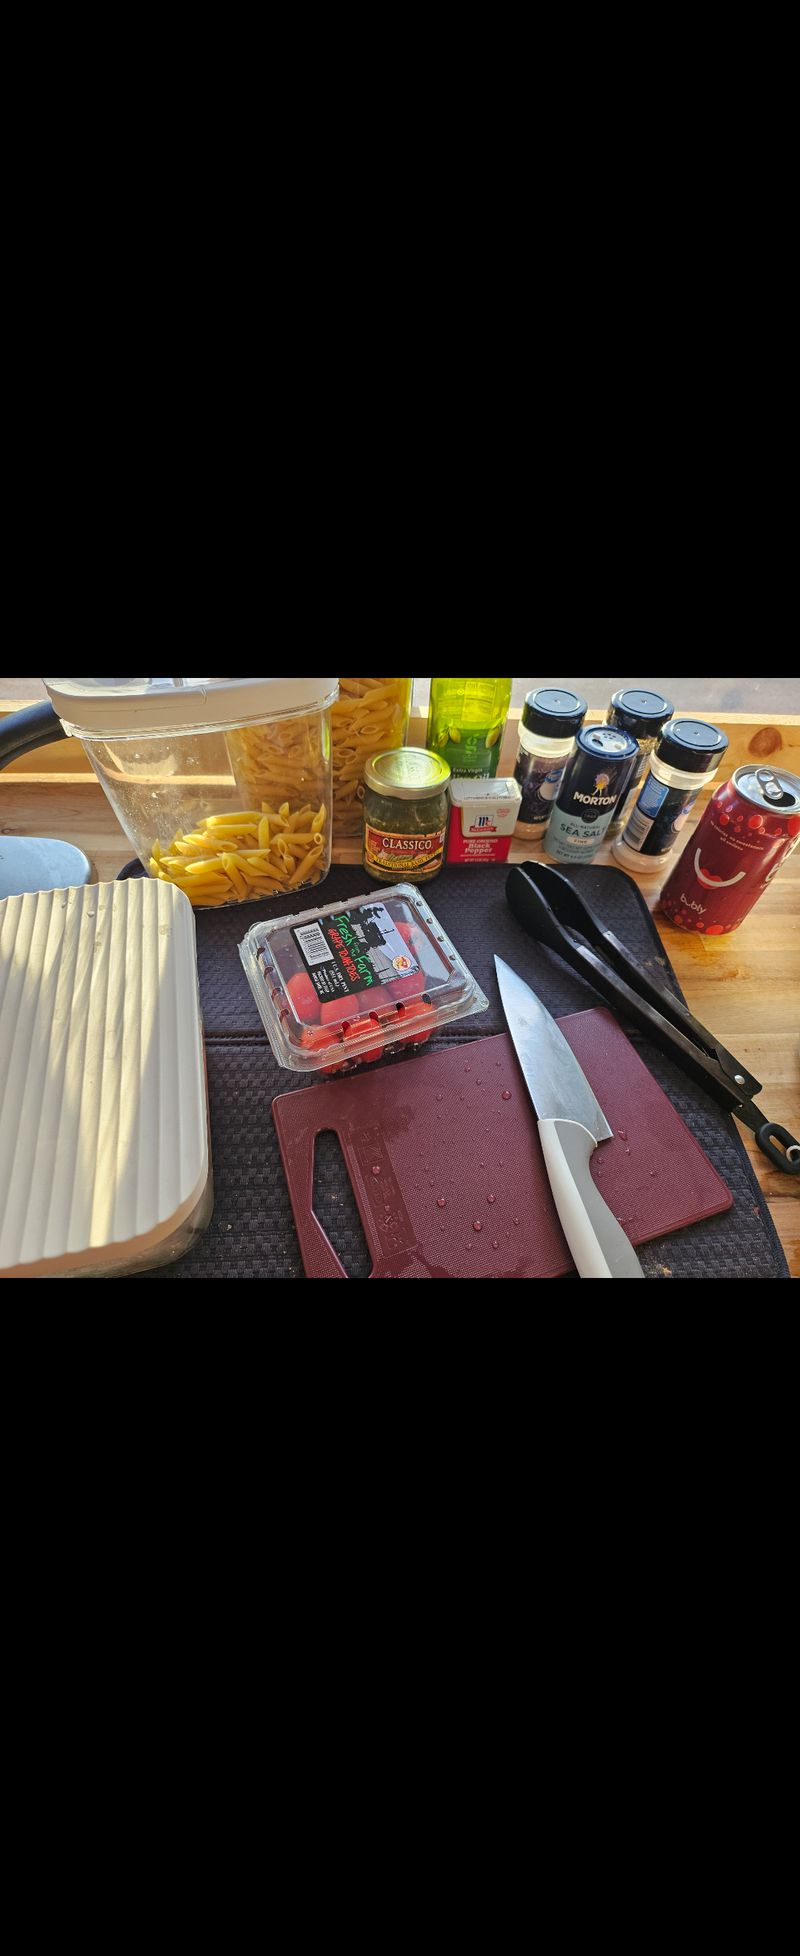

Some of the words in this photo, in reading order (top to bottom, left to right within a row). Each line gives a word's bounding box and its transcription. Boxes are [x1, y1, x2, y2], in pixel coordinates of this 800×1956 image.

[573, 791, 617, 805] MORTON
[560, 823, 579, 837] SEA
[582, 827, 606, 838] SALT
[382, 837, 432, 850] CLASSICO
[680, 892, 707, 915] bubly
[328, 928, 345, 948] GRAPE
[338, 948, 361, 982] TOMATOES
[335, 915, 357, 947] Fresh
[354, 955, 373, 986] Farm
